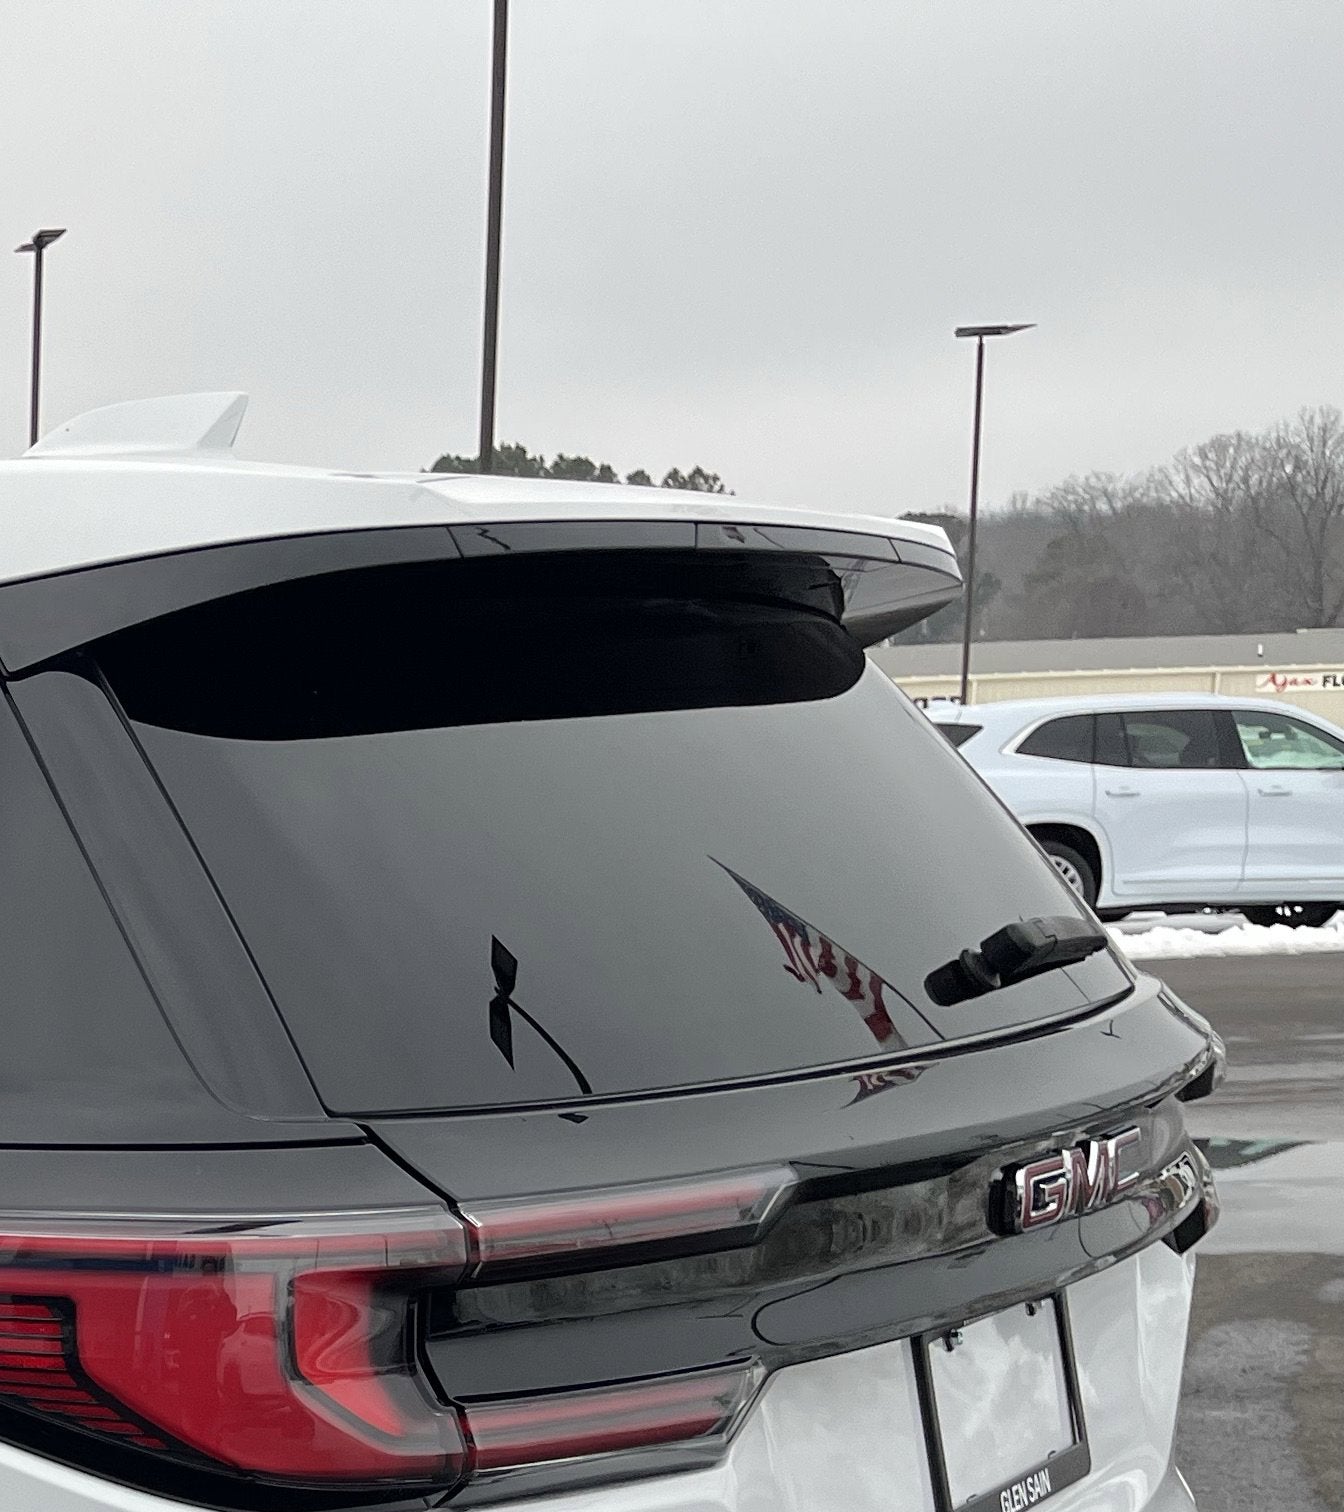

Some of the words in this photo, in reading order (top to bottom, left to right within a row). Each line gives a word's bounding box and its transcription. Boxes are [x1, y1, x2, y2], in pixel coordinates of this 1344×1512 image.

[1322, 674, 1344, 688] FL
[1015, 1126, 1141, 1233] GMC
[1026, 1467, 1051, 1503] SAIN
